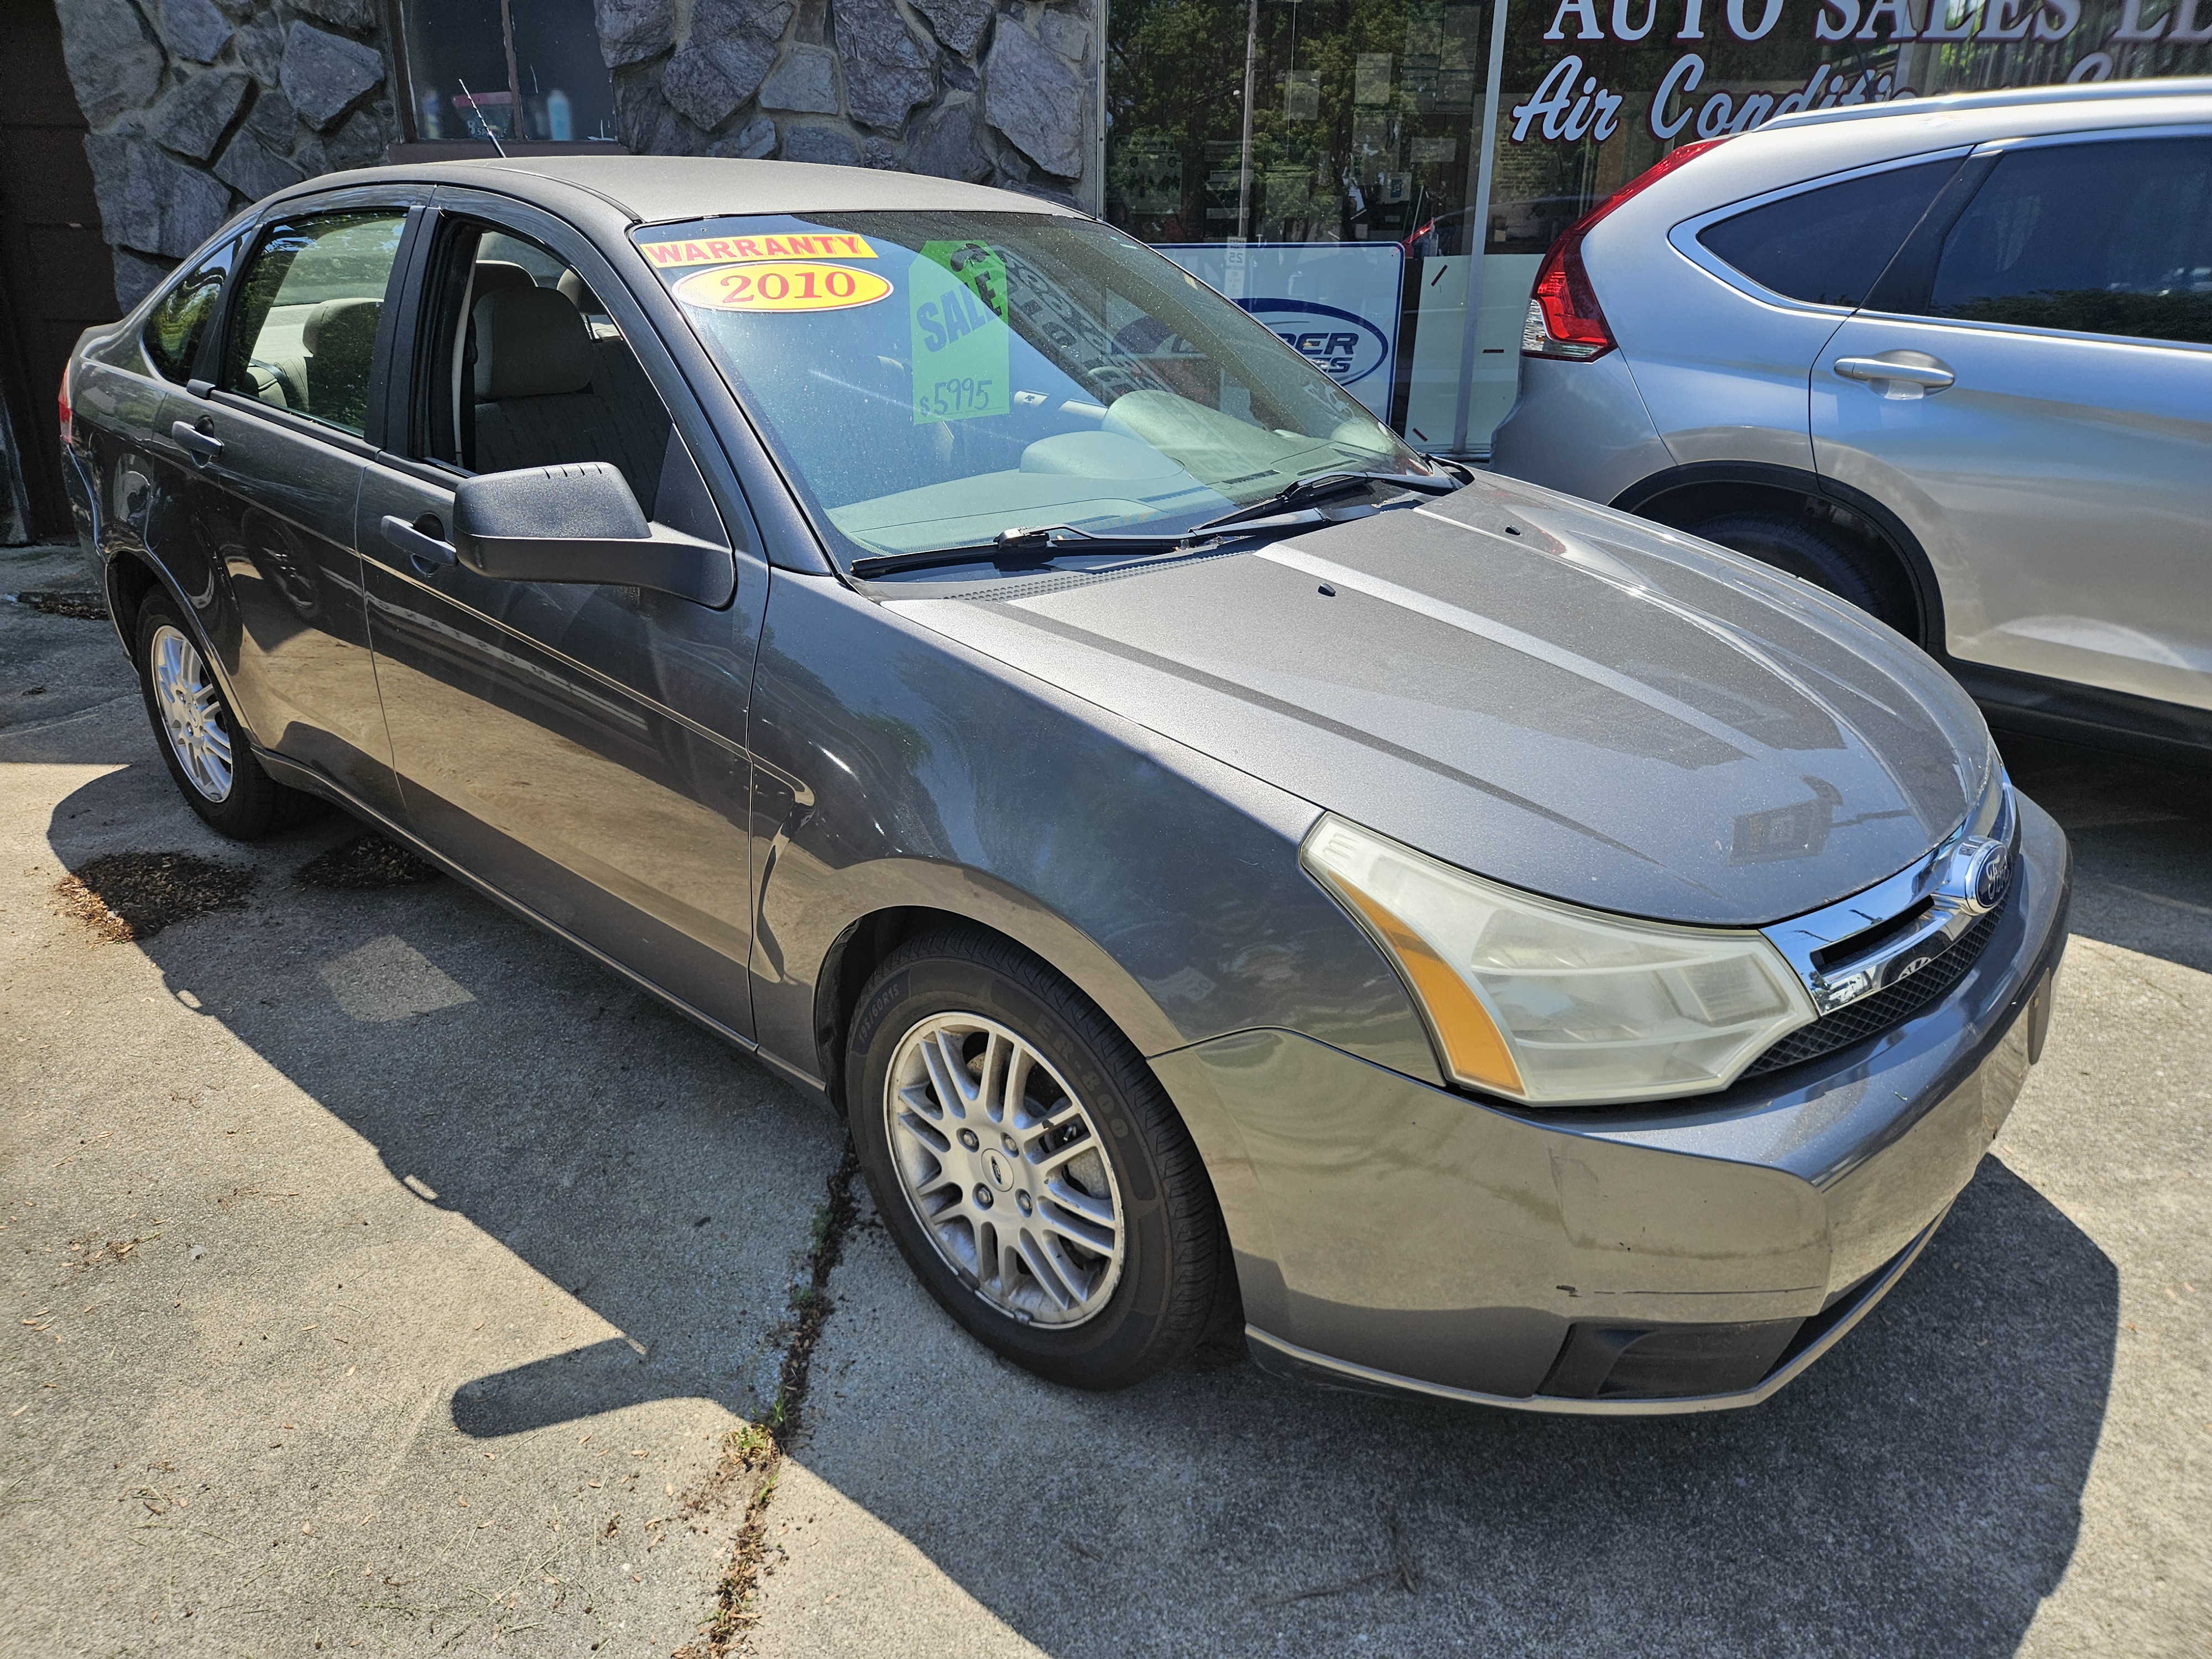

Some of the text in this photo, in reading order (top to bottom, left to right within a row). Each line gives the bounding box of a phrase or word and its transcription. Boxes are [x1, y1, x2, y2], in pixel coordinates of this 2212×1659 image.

[1512, 55, 1623, 142] Air
[646, 236, 863, 264] WARRANTY
[720, 271, 856, 304] 2010
[916, 270, 1003, 352] SALE
[919, 378, 993, 418] $5995
[1986, 854, 2010, 900] Ford
